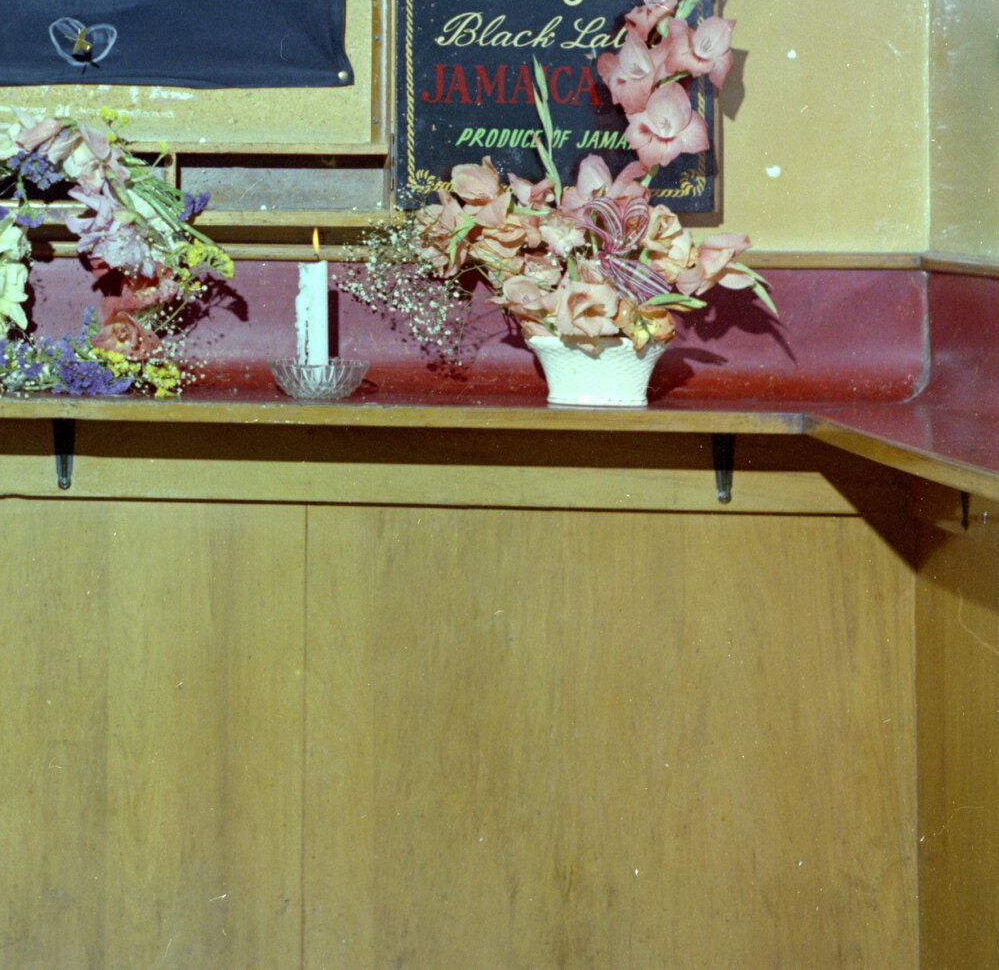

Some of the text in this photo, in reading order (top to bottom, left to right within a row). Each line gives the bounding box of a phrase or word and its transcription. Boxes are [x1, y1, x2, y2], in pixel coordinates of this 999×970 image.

[434, 11, 564, 48] Black
[421, 63, 603, 106] JAMACA
[456, 127, 543, 149] PRODUCE
[577, 130, 632, 149] JAMA
